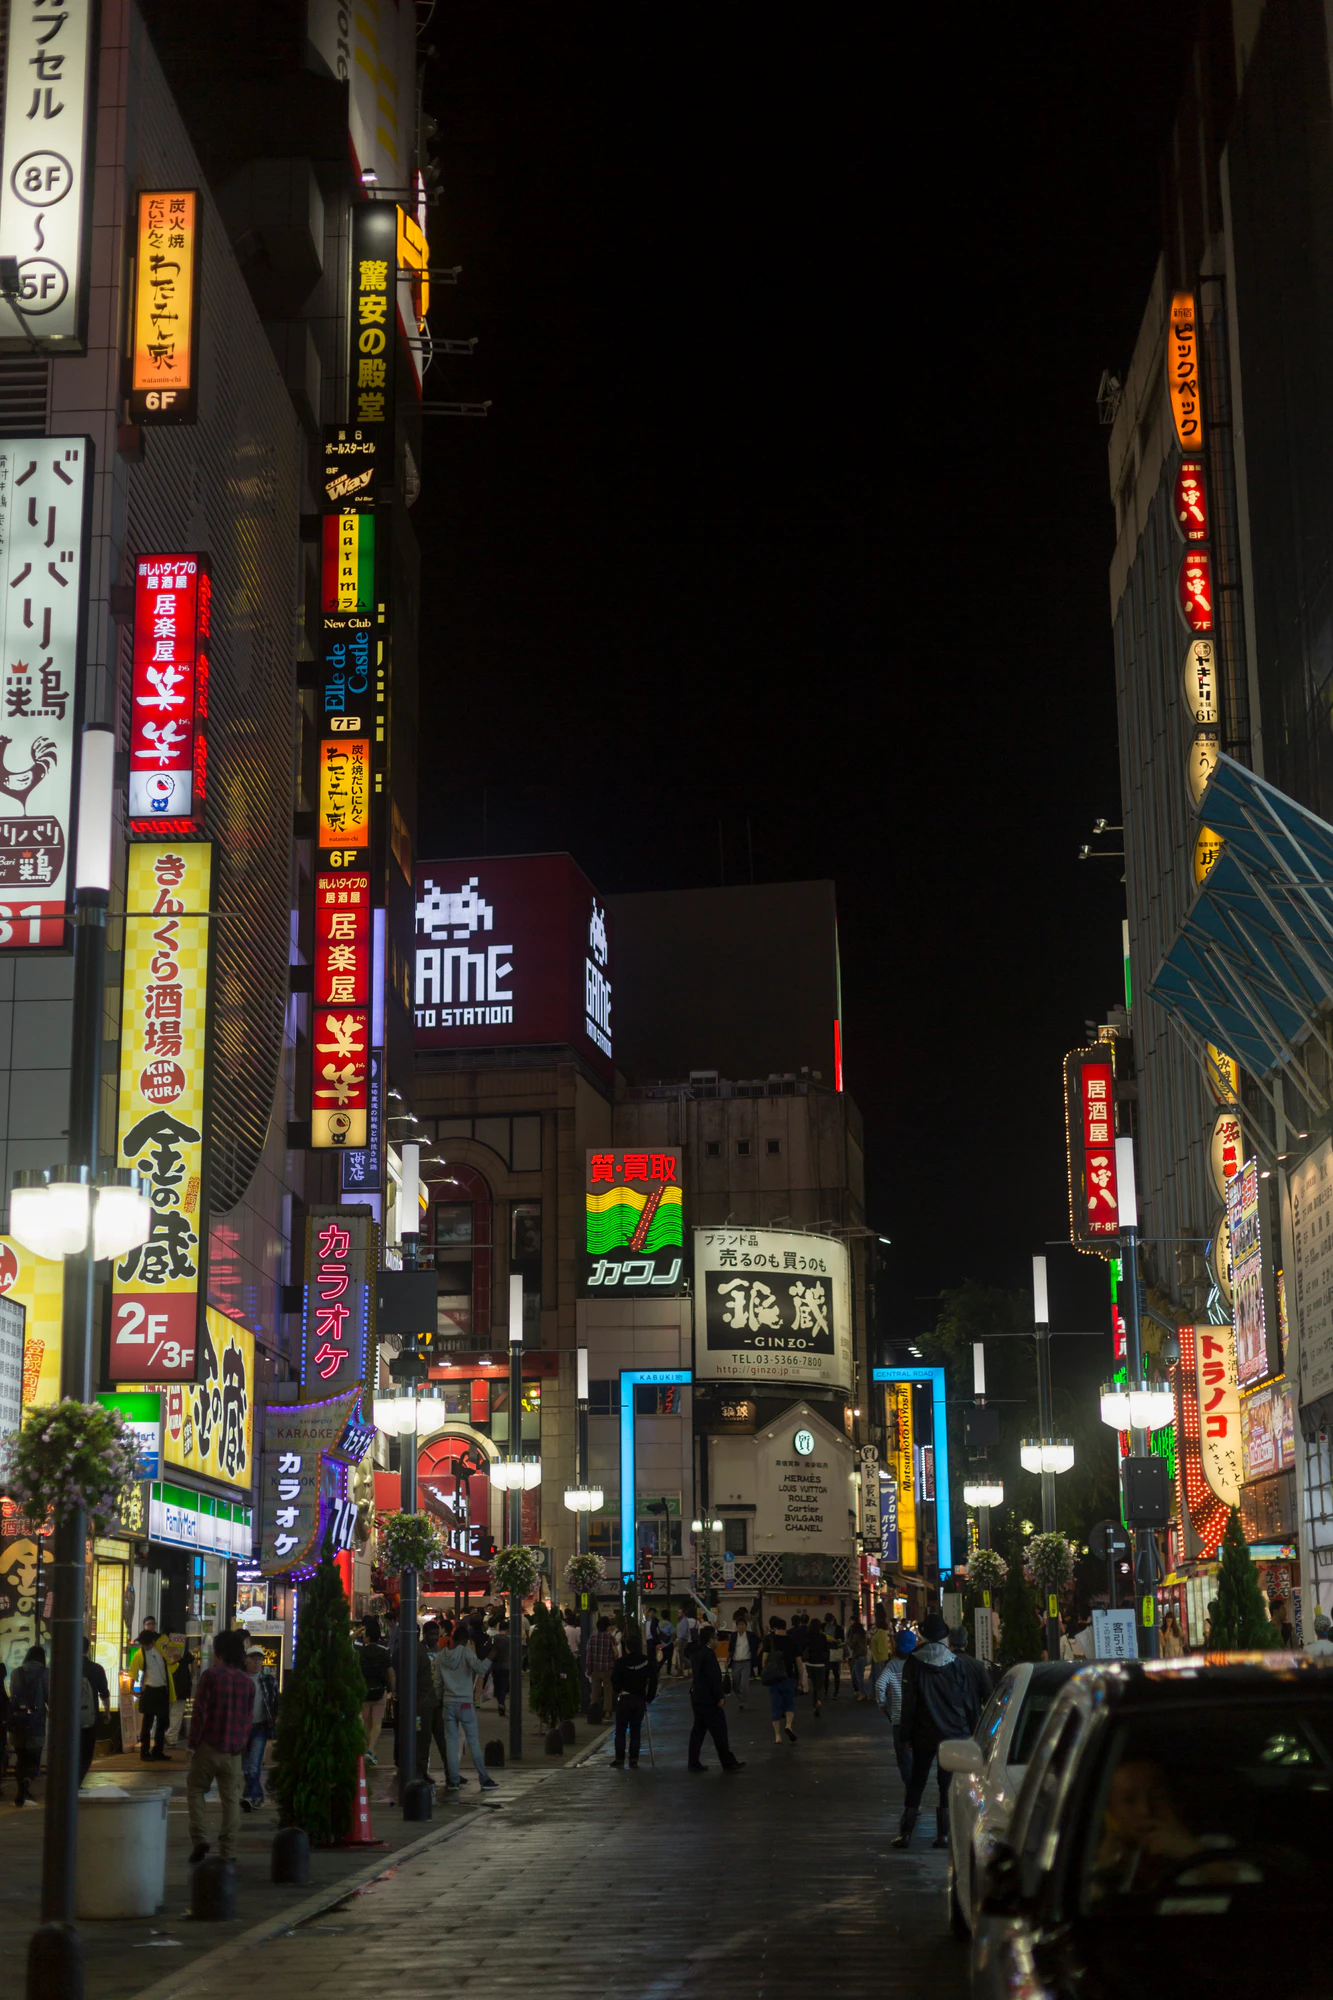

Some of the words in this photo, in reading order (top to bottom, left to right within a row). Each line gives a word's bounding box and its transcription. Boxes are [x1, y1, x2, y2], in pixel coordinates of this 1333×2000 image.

[26, 0, 69, 120] プセル
[23, 165, 62, 192] 8F
[148, 199, 165, 249] だいにんぐ
[168, 199, 186, 248] 炭火焼
[146, 253, 181, 370] わたみん家
[1173, 307, 1193, 318] 新宿
[357, 260, 388, 422] 驚安の殿堂
[141, 375, 182, 384] watamin-chi
[145, 391, 177, 410] 6F
[326, 468, 374, 501] Way
[343, 507, 356, 515] 7F
[1179, 480, 1205, 523] つぼ八
[1188, 531, 1205, 539] 8F
[339, 519, 357, 591] Garam
[138, 561, 198, 576] 新しいタイプの
[146, 576, 188, 589] 居酒屋
[1184, 567, 1211, 613] つぼ八
[329, 597, 367, 609] ガラム
[152, 593, 177, 662] 居楽屋
[323, 618, 346, 629] New
[347, 618, 372, 629] Club
[1192, 621, 1211, 630] 7F
[332, 643, 346, 668] de
[347, 632, 369, 694] Castle
[325, 675, 345, 713] Elle
[333, 719, 358, 730] 7F
[1196, 709, 1217, 722] 6F
[326, 746, 350, 833] わたみん家
[351, 744, 365, 825] 炭火焼だいにんぐ
[0, 822, 59, 846] リバリ
[329, 850, 358, 868] 6F
[318, 877, 368, 890] 新しいタイプの
[325, 891, 361, 904] 居酒屋
[142, 853, 186, 1058] きんくら酒場
[326, 913, 359, 1004] 居楽屋
[441, 1005, 513, 1026] STATION
[147, 1061, 177, 1074] KIN
[153, 1075, 171, 1085] no
[143, 1085, 185, 1098] KURA
[1087, 1080, 1109, 1142] 居酒屋
[1087, 1156, 1117, 1210] つぼ八
[705, 1234, 759, 1247] ブランド品
[587, 1258, 682, 1286] カワノ
[719, 1249, 828, 1273] 売るのも買うのも
[314, 1223, 351, 1380] カラオケ
[717, 1278, 830, 1338] 銀蔵
[116, 1302, 169, 1344] 2F
[639, 1373, 683, 1382] KABUKI町
[716, 1364, 789, 1376] http://ginzo.jp
[912, 1370, 934, 1378] ROAD
[1201, 1335, 1228, 1439] トラノコ
[1208, 1443, 1229, 1487] やきとん
[779, 1485, 797, 1493] LOUIS
[800, 1485, 828, 1494] VUITTON
[788, 1494, 818, 1503] ROLEX
[273, 1452, 302, 1556] カラオケ
[787, 1504, 819, 1512] Cartier
[888, 1495, 897, 1532] クロサワ
[166, 1507, 196, 1540] FamilyMart
[331, 1497, 359, 1549] 747
[784, 1513, 824, 1522] BVLGARI
[785, 1523, 822, 1532] CHANEL
[881, 1514, 889, 1559] バイオリン
